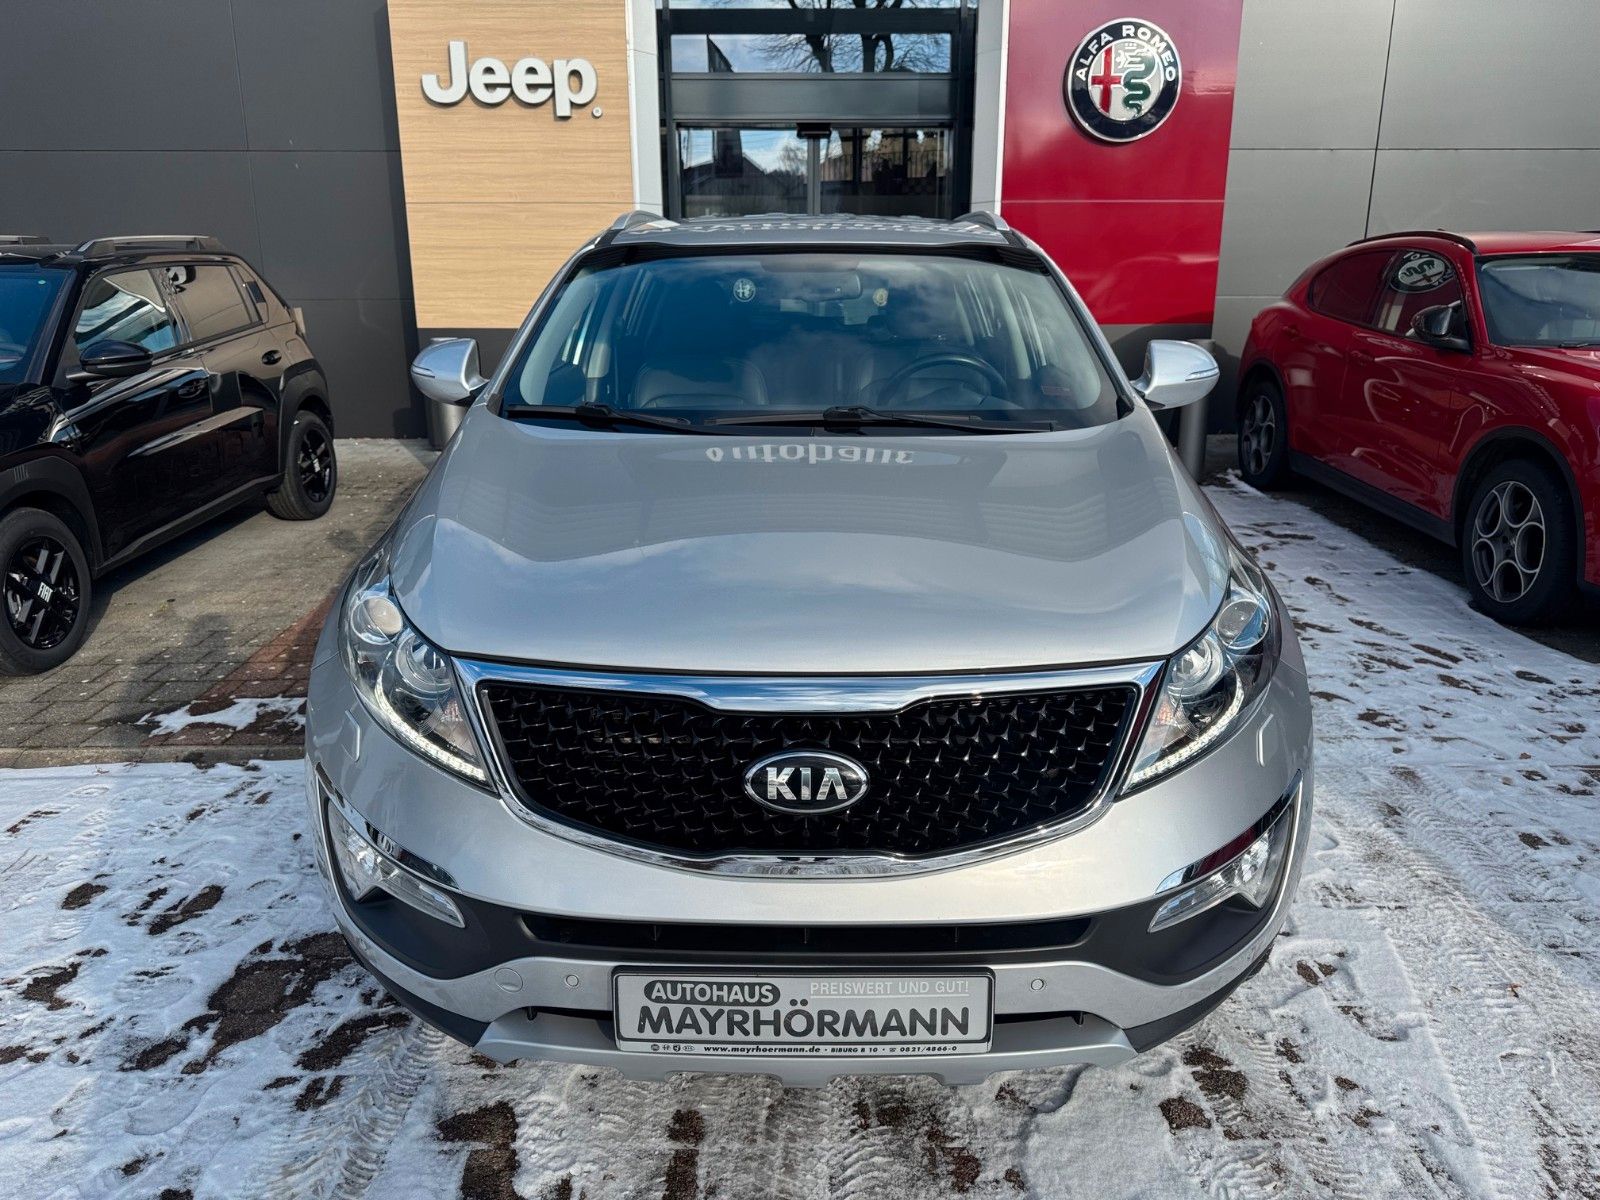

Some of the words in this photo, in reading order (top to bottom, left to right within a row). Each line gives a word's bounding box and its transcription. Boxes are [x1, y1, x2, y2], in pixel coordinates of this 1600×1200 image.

[1076, 32, 1113, 81] ALFA
[1122, 25, 1176, 81] ROMEO
[38, 582, 53, 602] FIAT
[766, 767, 848, 800] KIA
[651, 982, 774, 1003] AUTOHAUS
[810, 981, 893, 995] PREISWERT
[898, 981, 930, 994] UND
[935, 981, 969, 993] GUT!
[637, 999, 969, 1037] MAYRHÖRMANN
[703, 1045, 821, 1053] www.mayrhoermann.de
